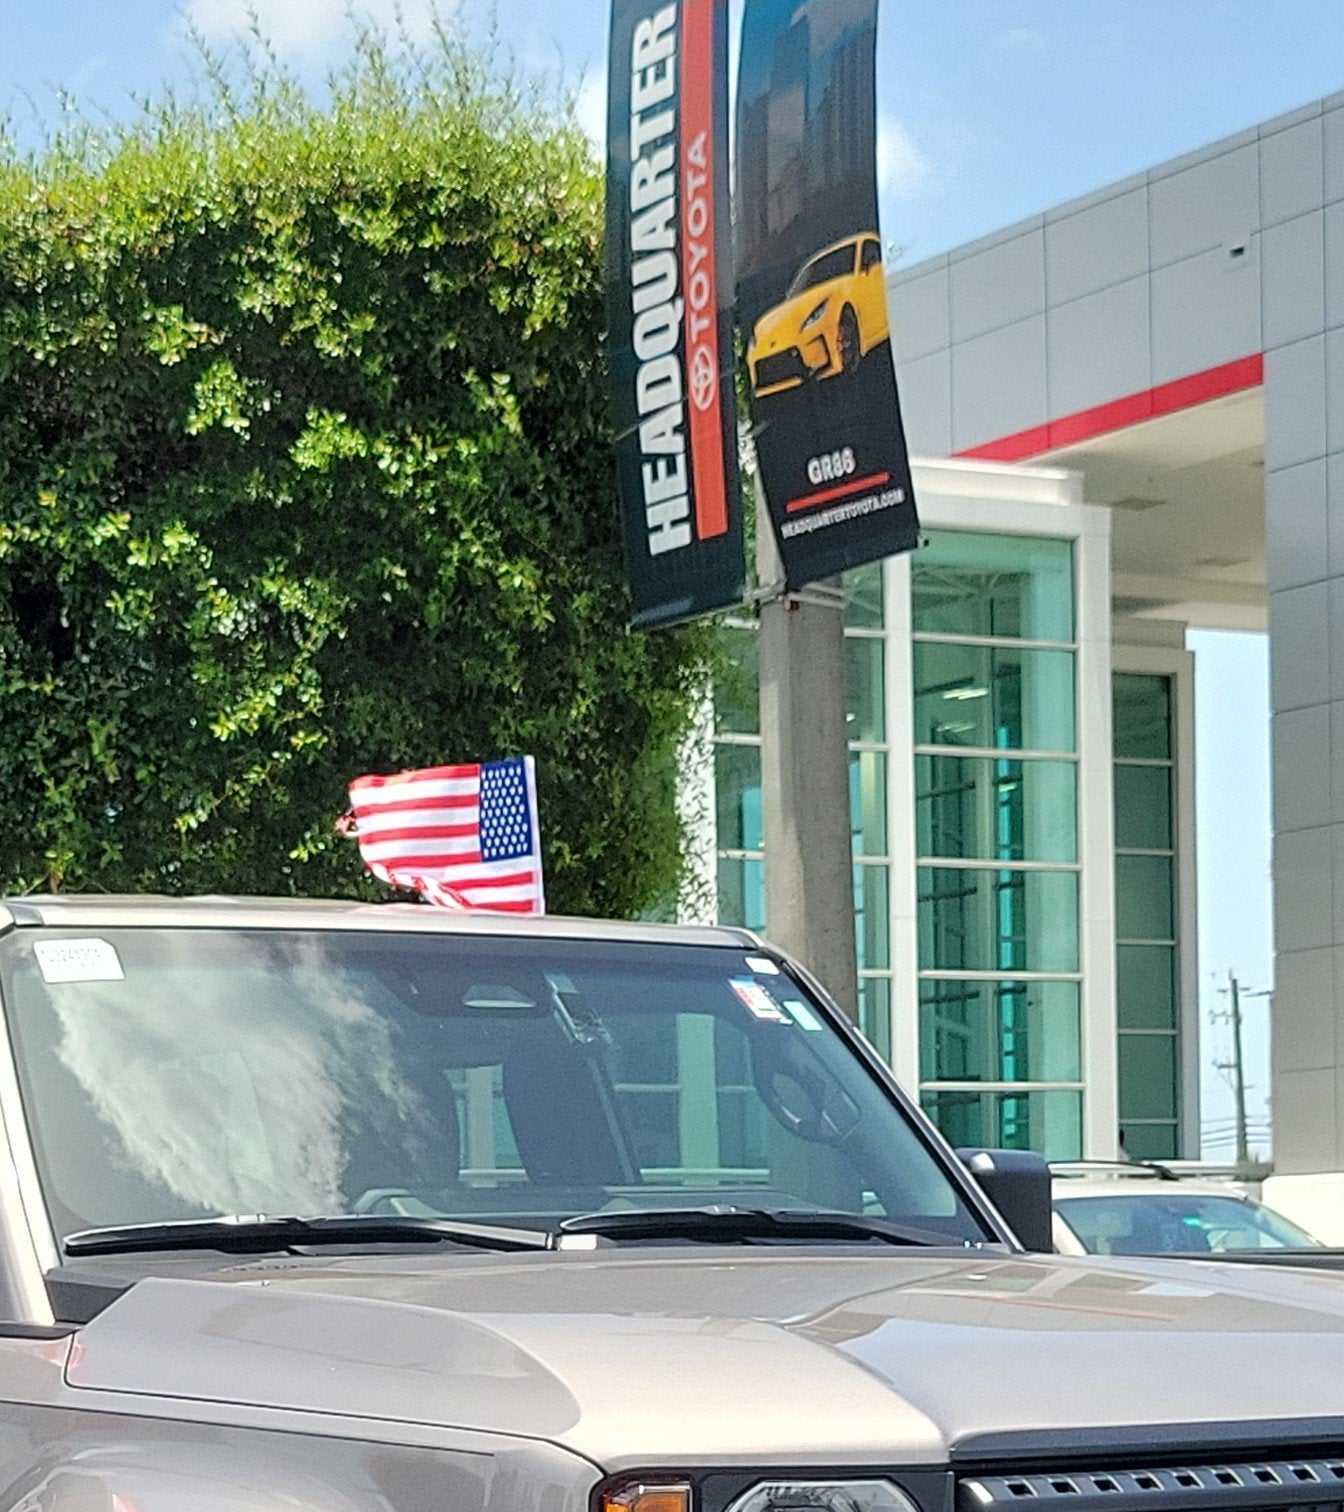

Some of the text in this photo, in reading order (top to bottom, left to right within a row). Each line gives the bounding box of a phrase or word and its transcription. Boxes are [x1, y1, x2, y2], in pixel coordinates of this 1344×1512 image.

[630, 2, 692, 556] HEADQUARTER
[686, 132, 710, 343] TOYOTA
[807, 446, 856, 485] GR86
